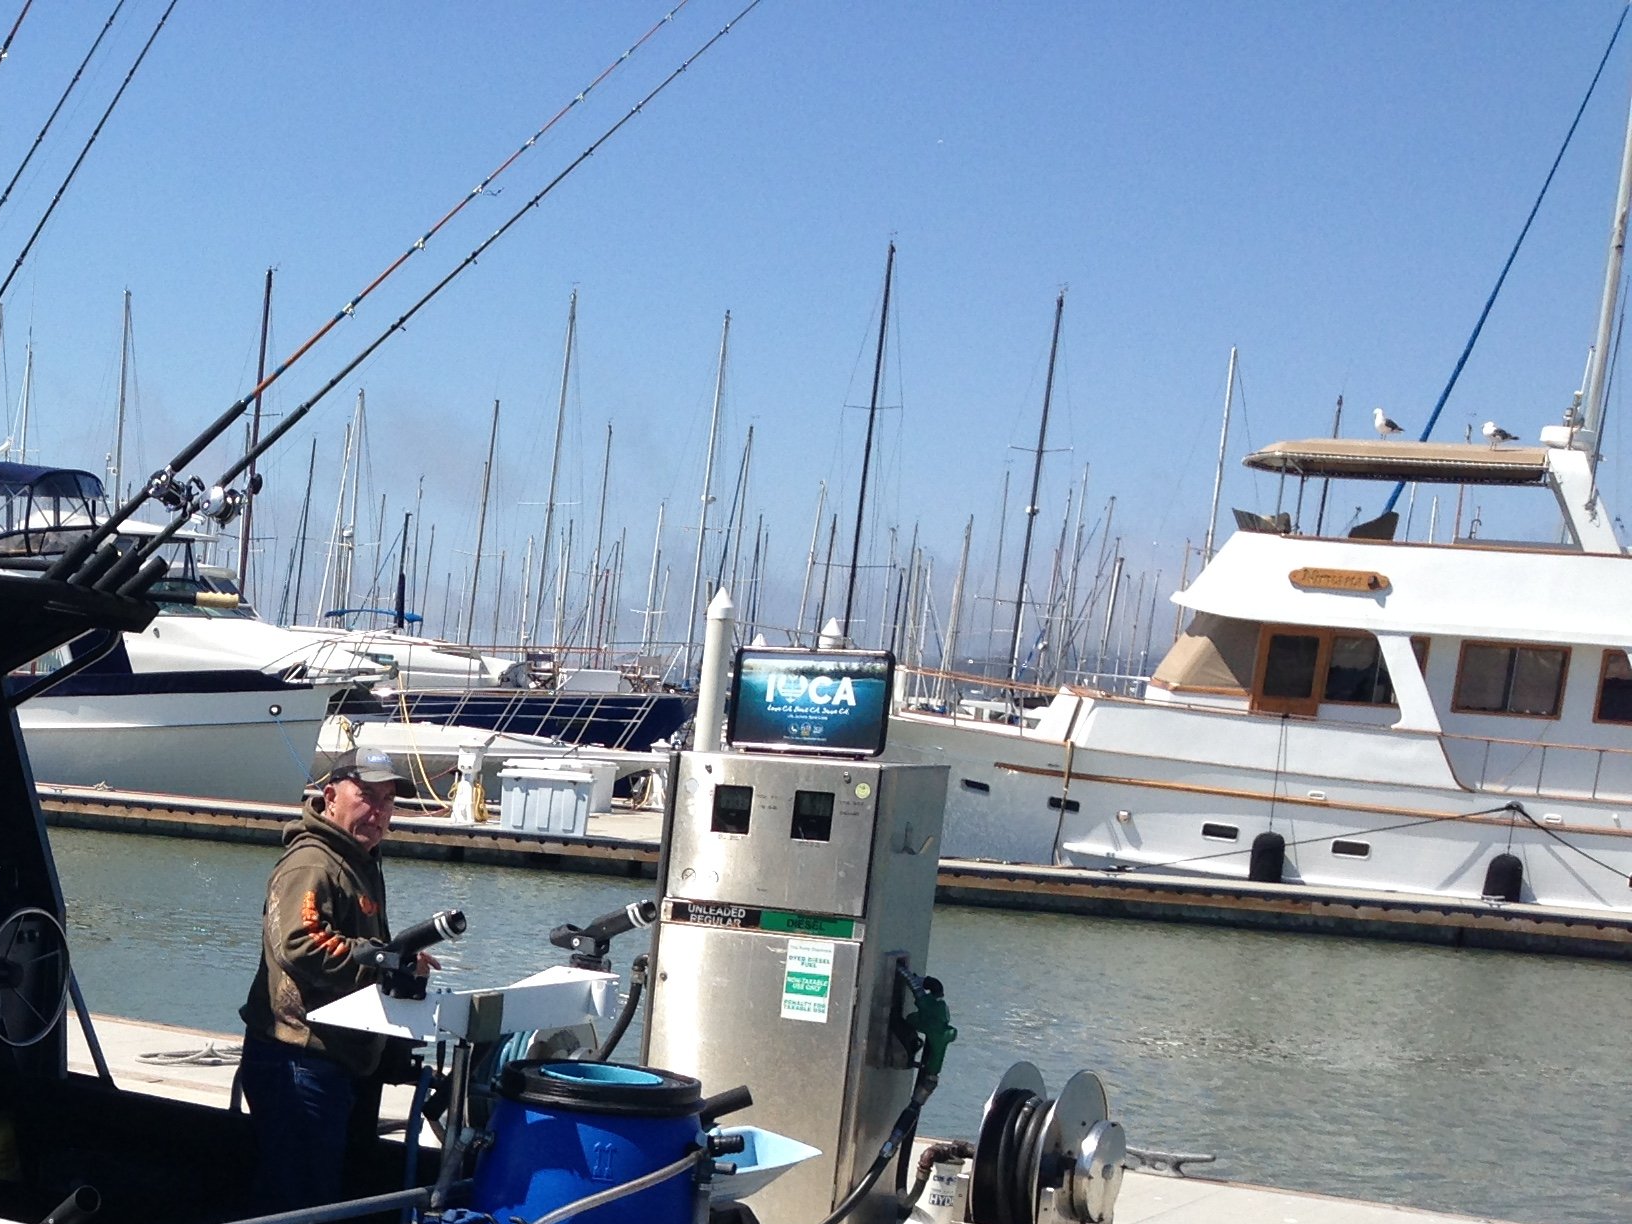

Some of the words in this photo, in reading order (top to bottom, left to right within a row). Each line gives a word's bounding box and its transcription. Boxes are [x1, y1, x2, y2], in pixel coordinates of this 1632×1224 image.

[687, 903, 747, 919] UNLEADED
[689, 913, 742, 928] REGULAR
[786, 918, 826, 931] DIESEL
[808, 956, 831, 965] DIESEL
